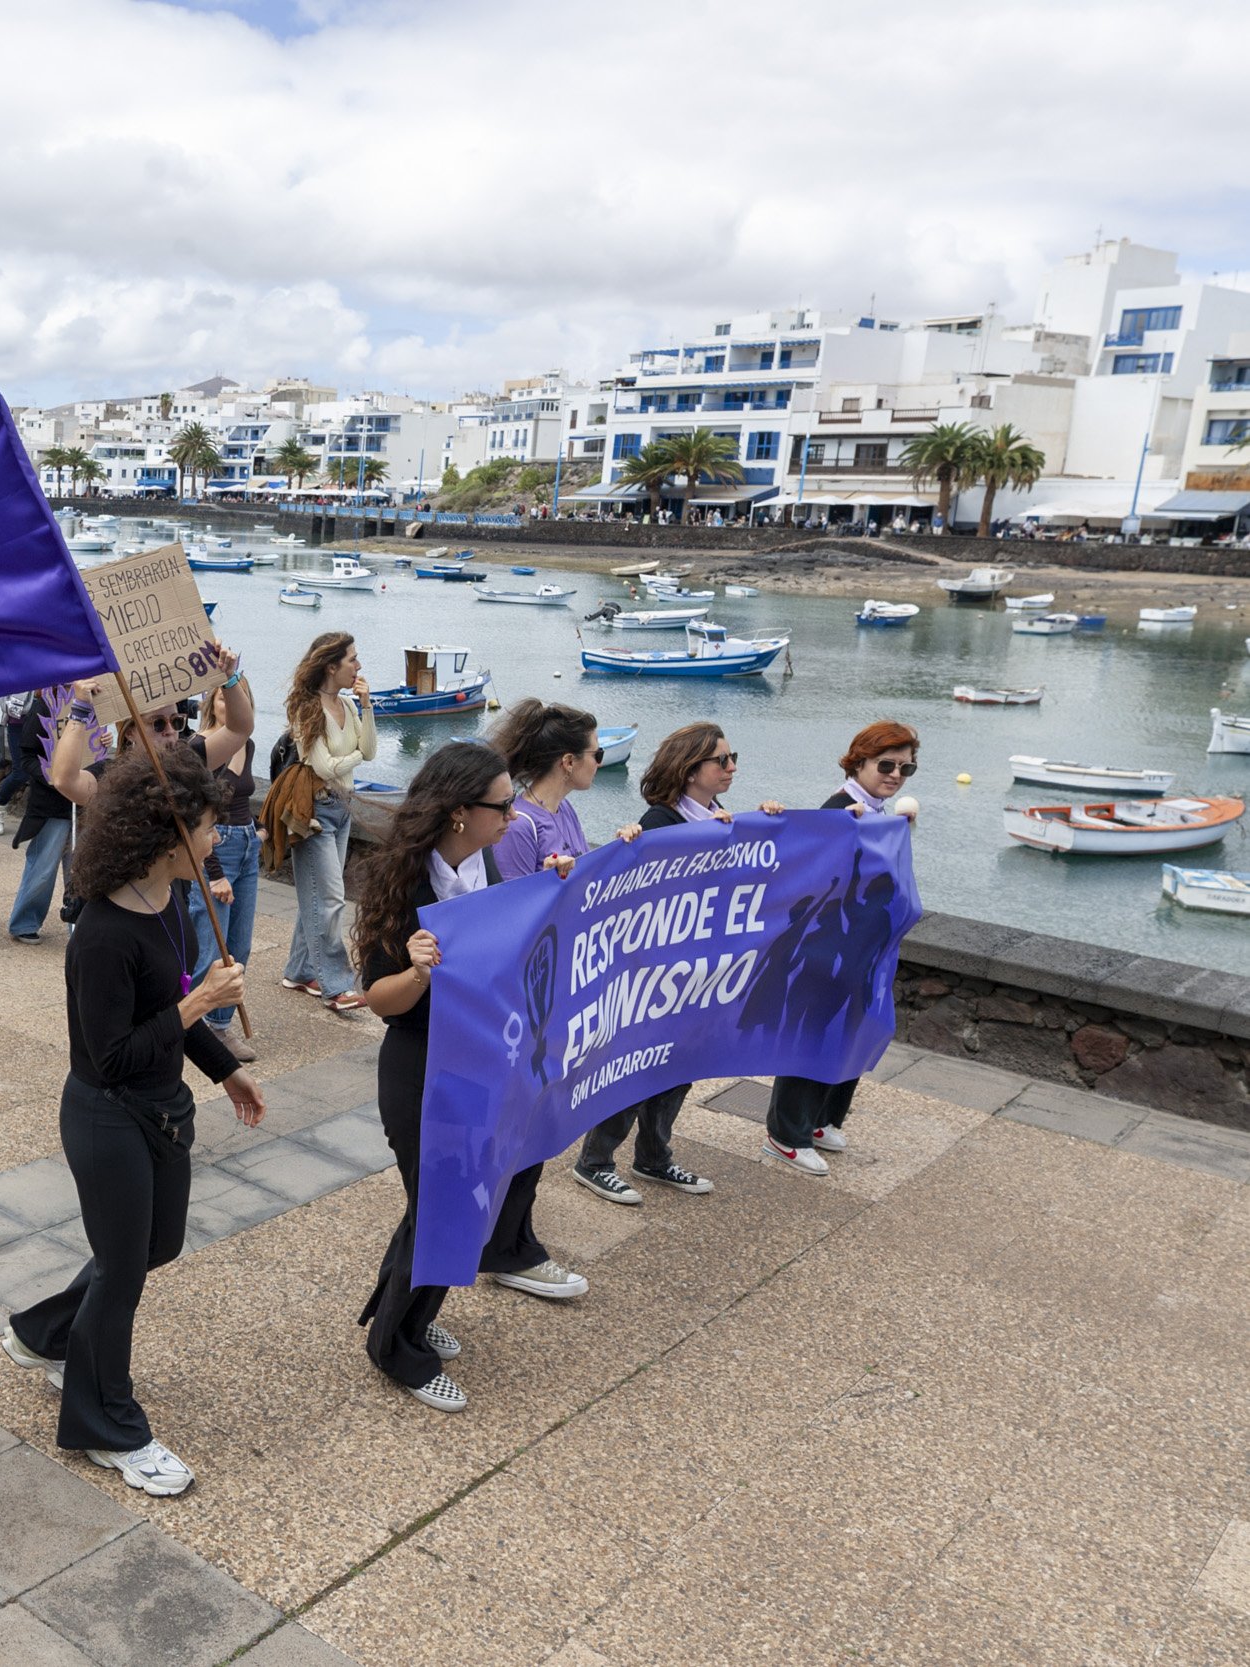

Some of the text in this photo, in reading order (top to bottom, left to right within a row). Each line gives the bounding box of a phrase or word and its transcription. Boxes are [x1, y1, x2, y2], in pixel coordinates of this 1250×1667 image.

[99, 555, 181, 598] SEMBRARON
[96, 594, 161, 635] MIEDO
[123, 622, 201, 664] CRECIERON
[130, 656, 192, 703] ALAS
[581, 840, 780, 912] SI AVANZA EL FASCISMO,
[570, 883, 767, 996] RESPONDE EL
[562, 949, 758, 1080] FEMINISMO
[570, 1042, 674, 1110] 8M LANZAROTE
